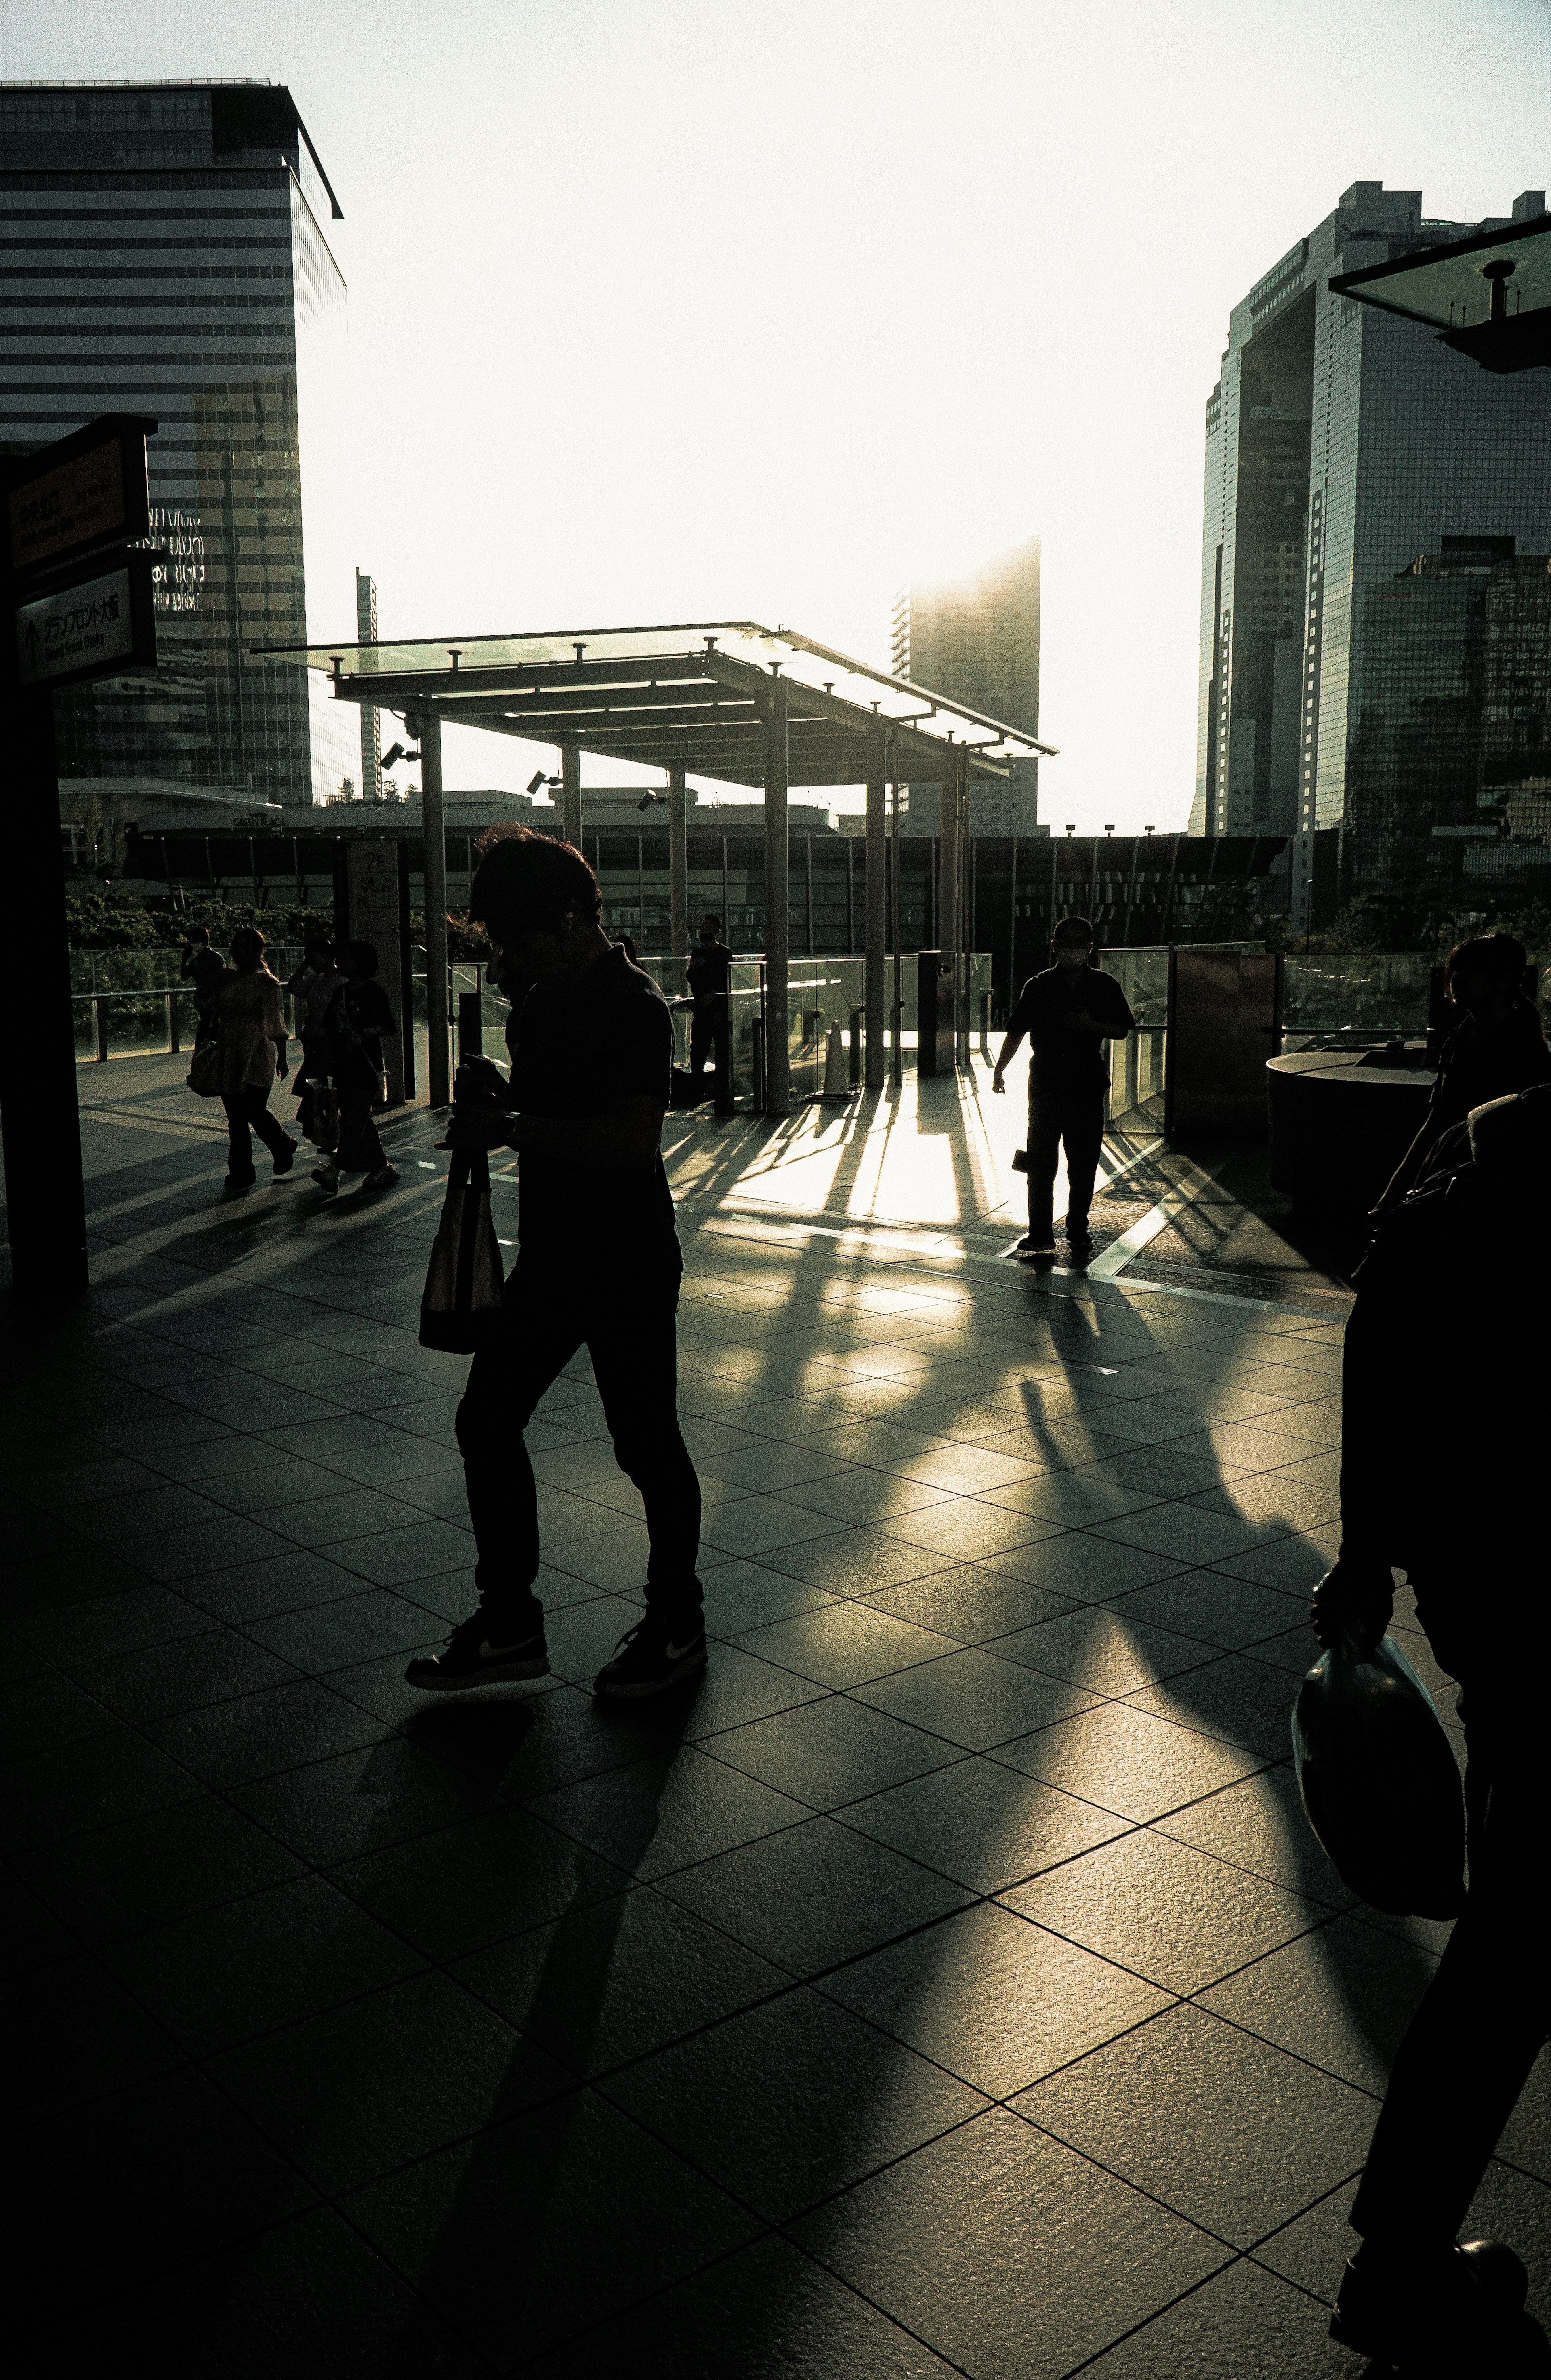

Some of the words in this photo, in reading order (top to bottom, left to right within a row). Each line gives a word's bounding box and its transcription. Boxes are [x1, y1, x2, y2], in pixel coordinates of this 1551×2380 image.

[44, 594, 120, 642] グランフロント大阪
[45, 642, 64, 661] Grand
[65, 640, 83, 655] Front
[84, 631, 104, 650] Osaka
[366, 852, 385, 869] 2F
